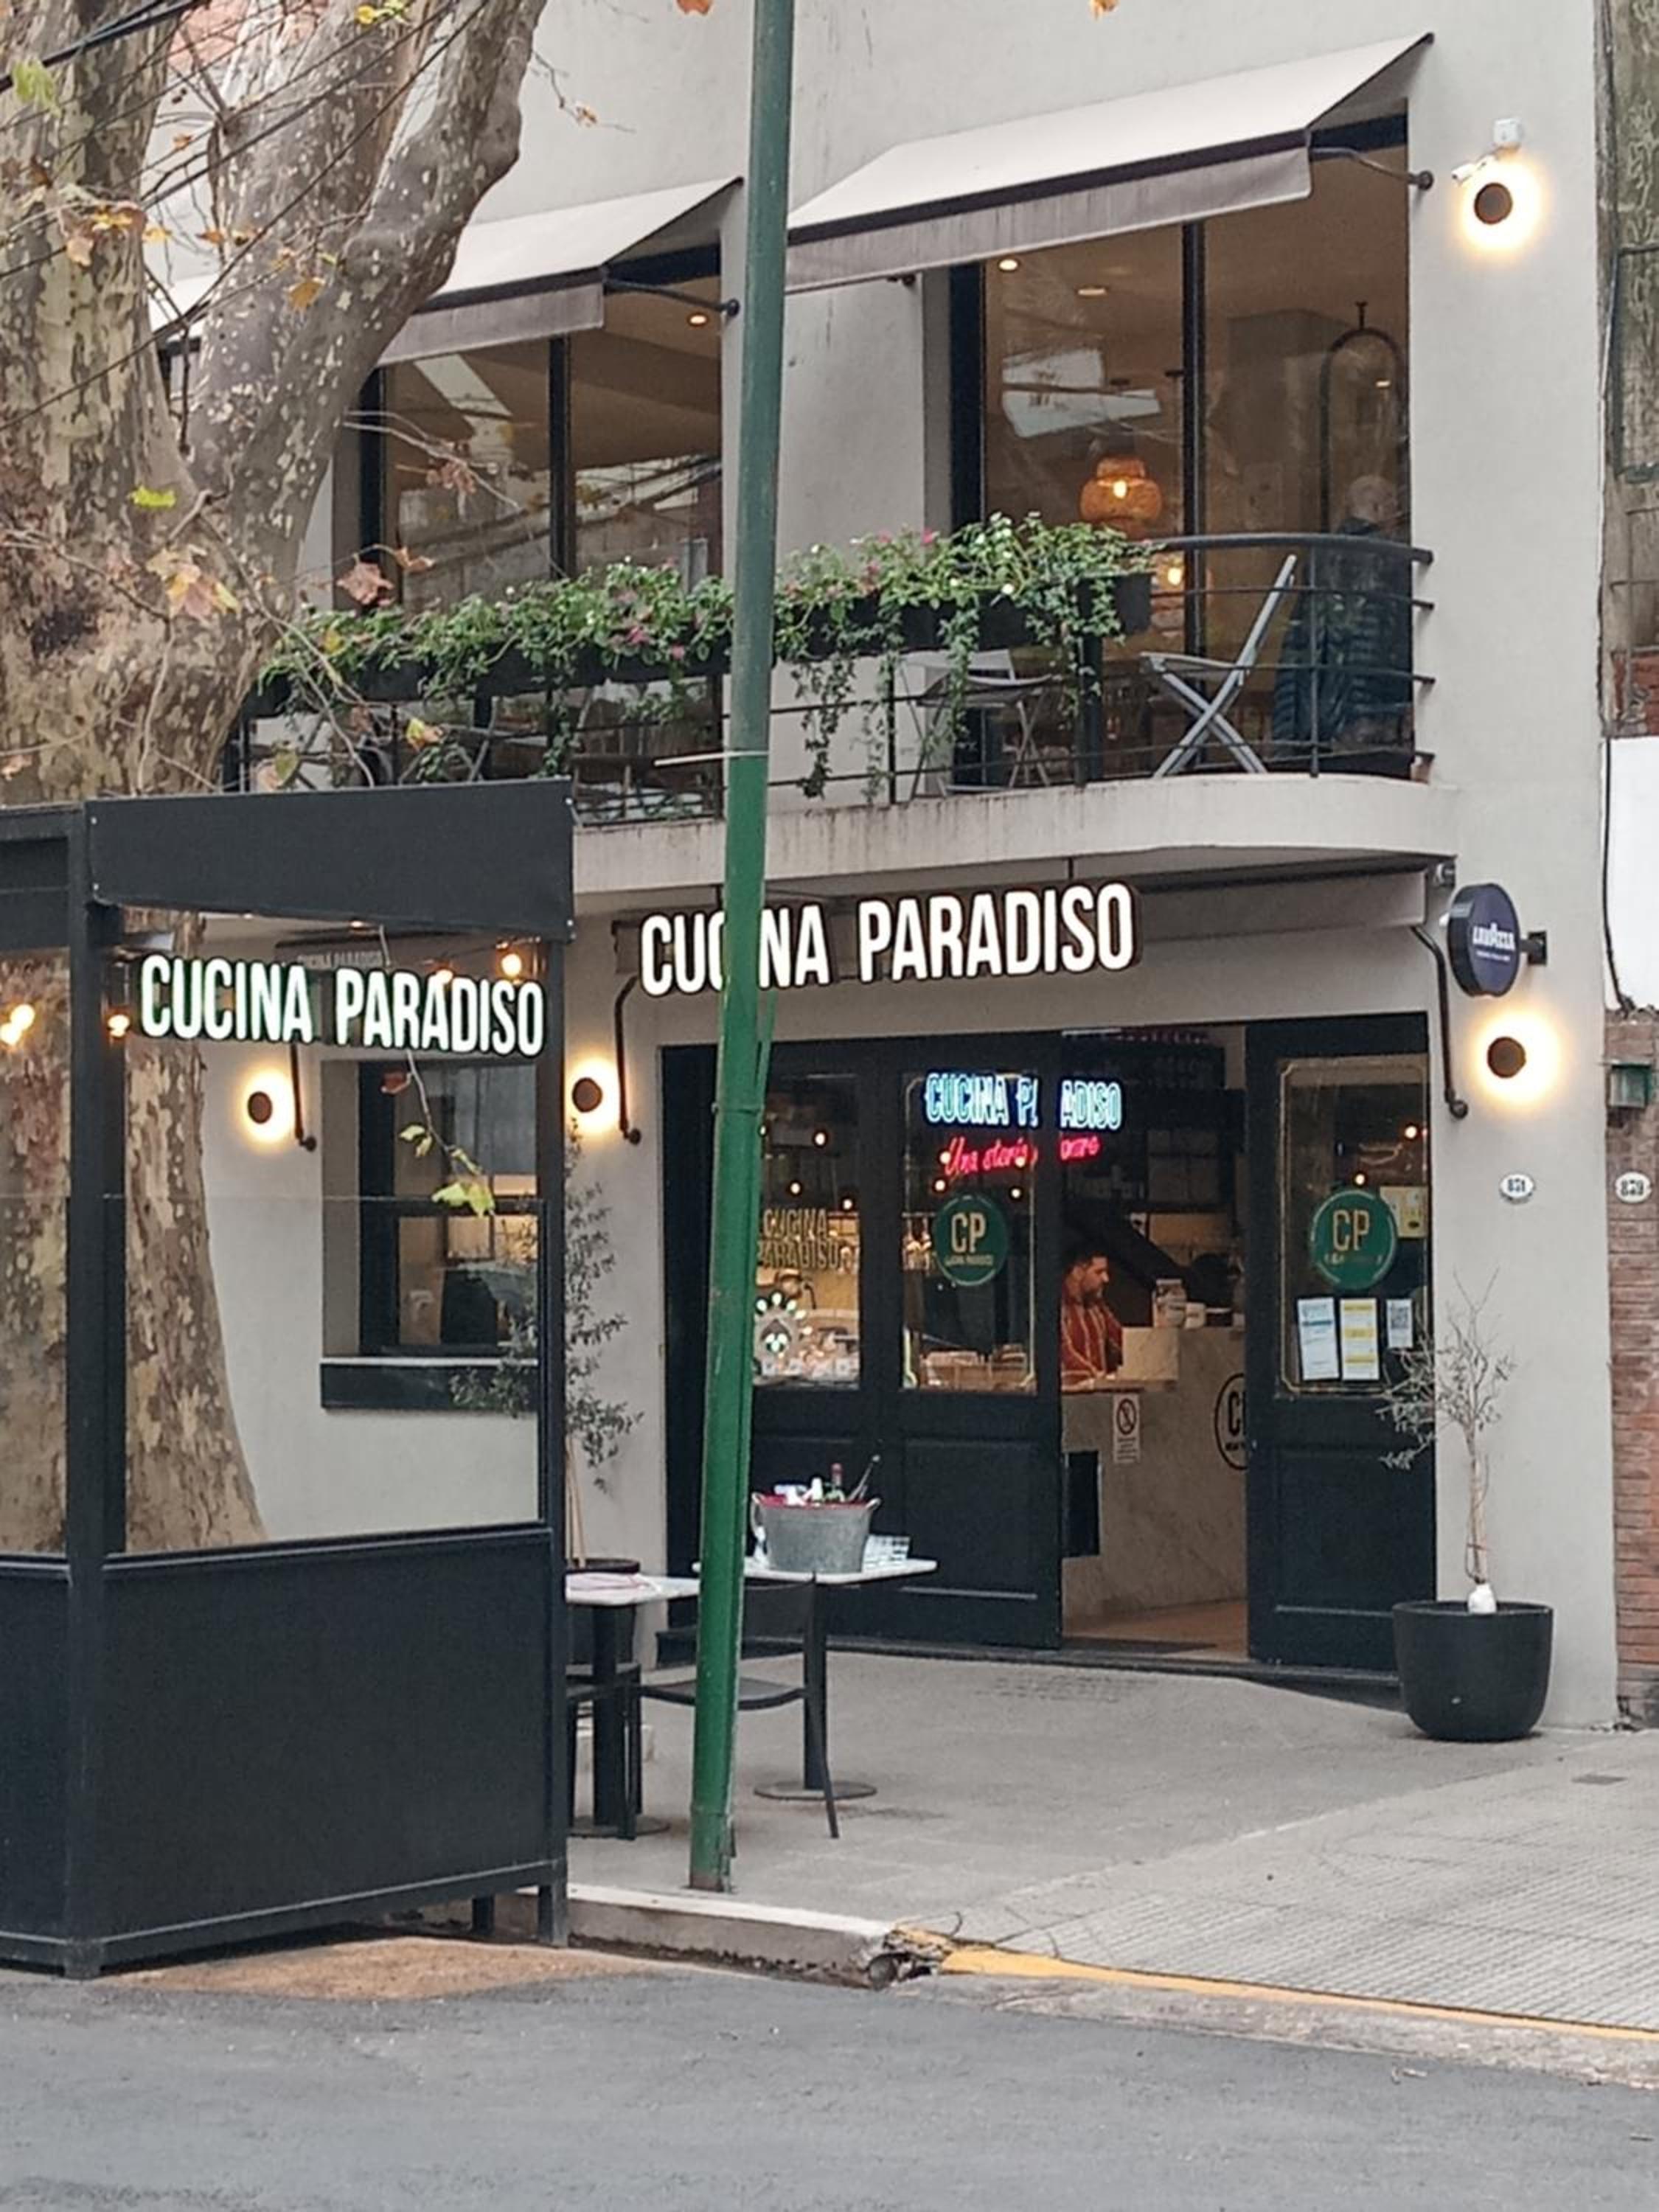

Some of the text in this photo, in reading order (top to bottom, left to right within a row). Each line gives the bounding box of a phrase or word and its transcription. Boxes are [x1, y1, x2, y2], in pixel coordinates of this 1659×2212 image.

[641, 883, 1134, 996] CUCNA PARADISO
[140, 955, 544, 1056] CUCINA PARADISO
[925, 1073, 1009, 1126] CUCINA
[763, 1208, 827, 1239] CUCINA
[951, 1212, 987, 1253] CP
[1333, 1209, 1370, 1251] CP
[1228, 1390, 1247, 1436] C
